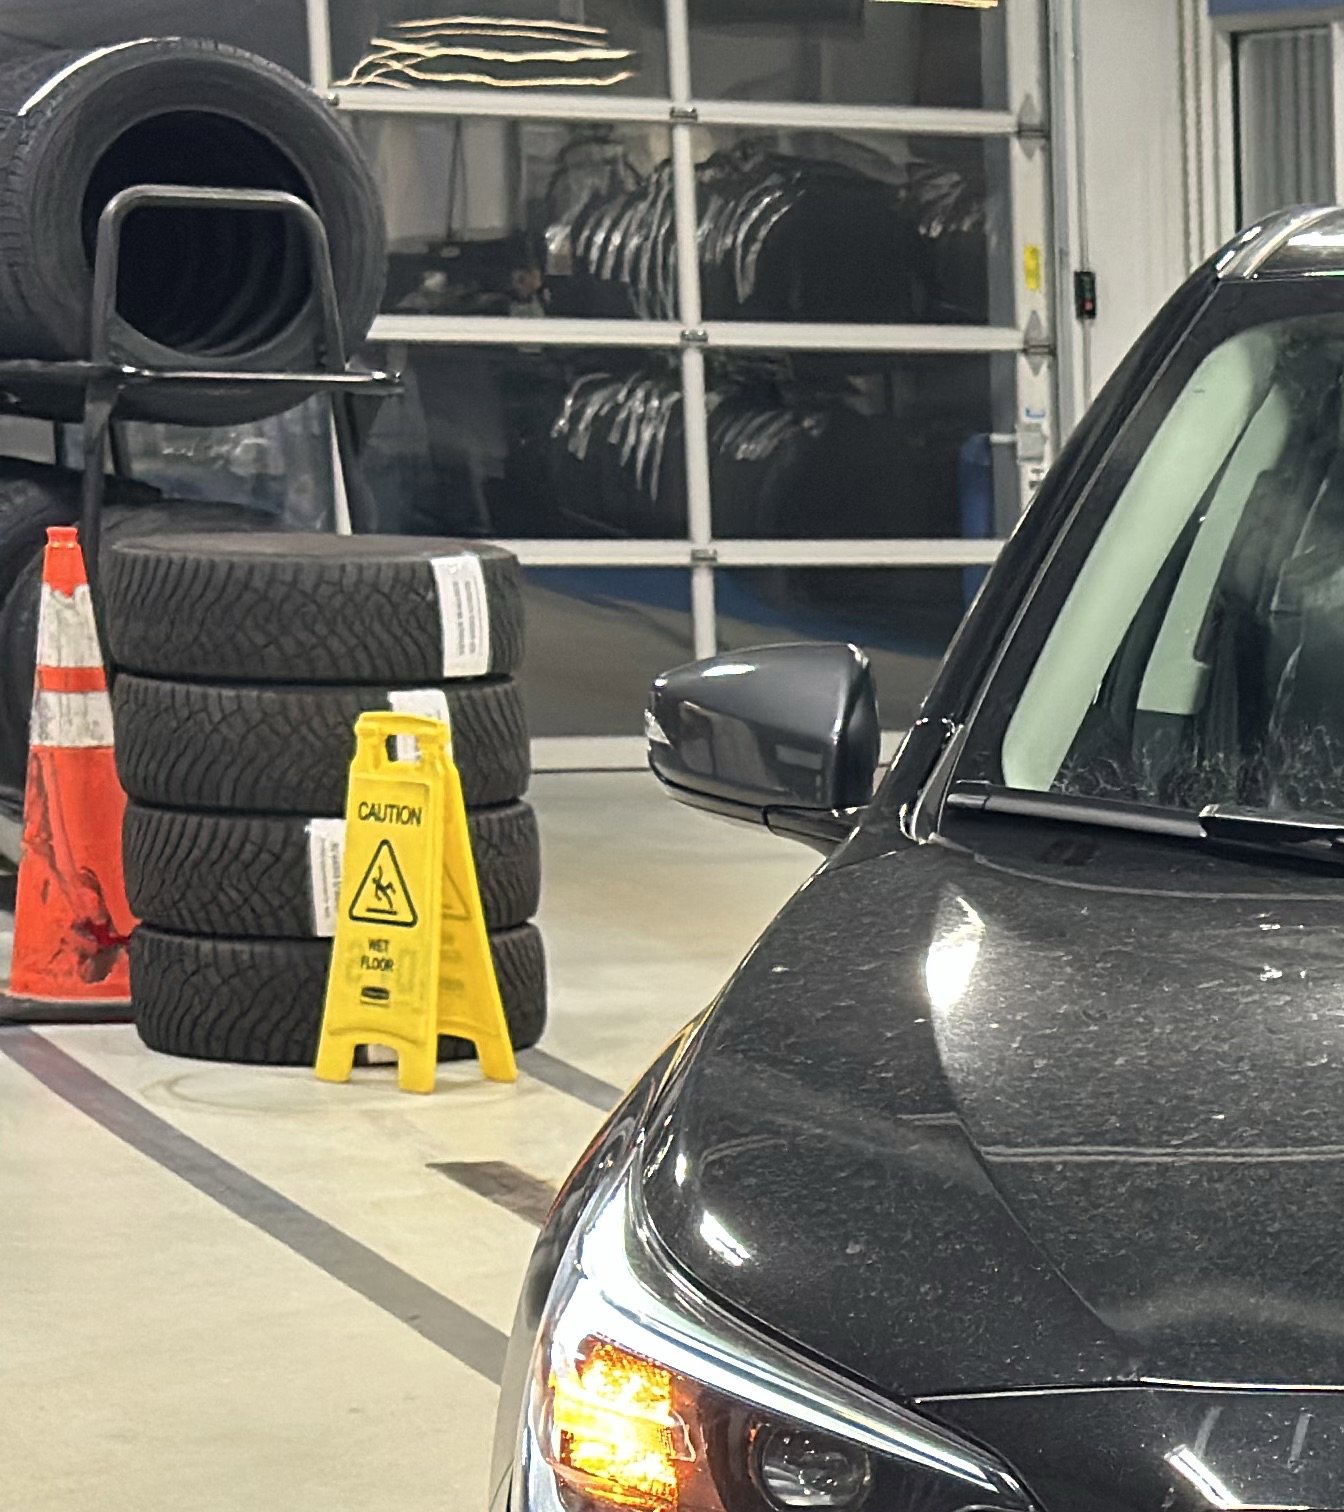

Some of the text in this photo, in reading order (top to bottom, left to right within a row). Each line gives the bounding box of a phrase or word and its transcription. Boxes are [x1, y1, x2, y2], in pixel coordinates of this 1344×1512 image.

[358, 801, 422, 826] CAUTION
[368, 939, 390, 953] WET
[360, 956, 394, 972] FLOOR
